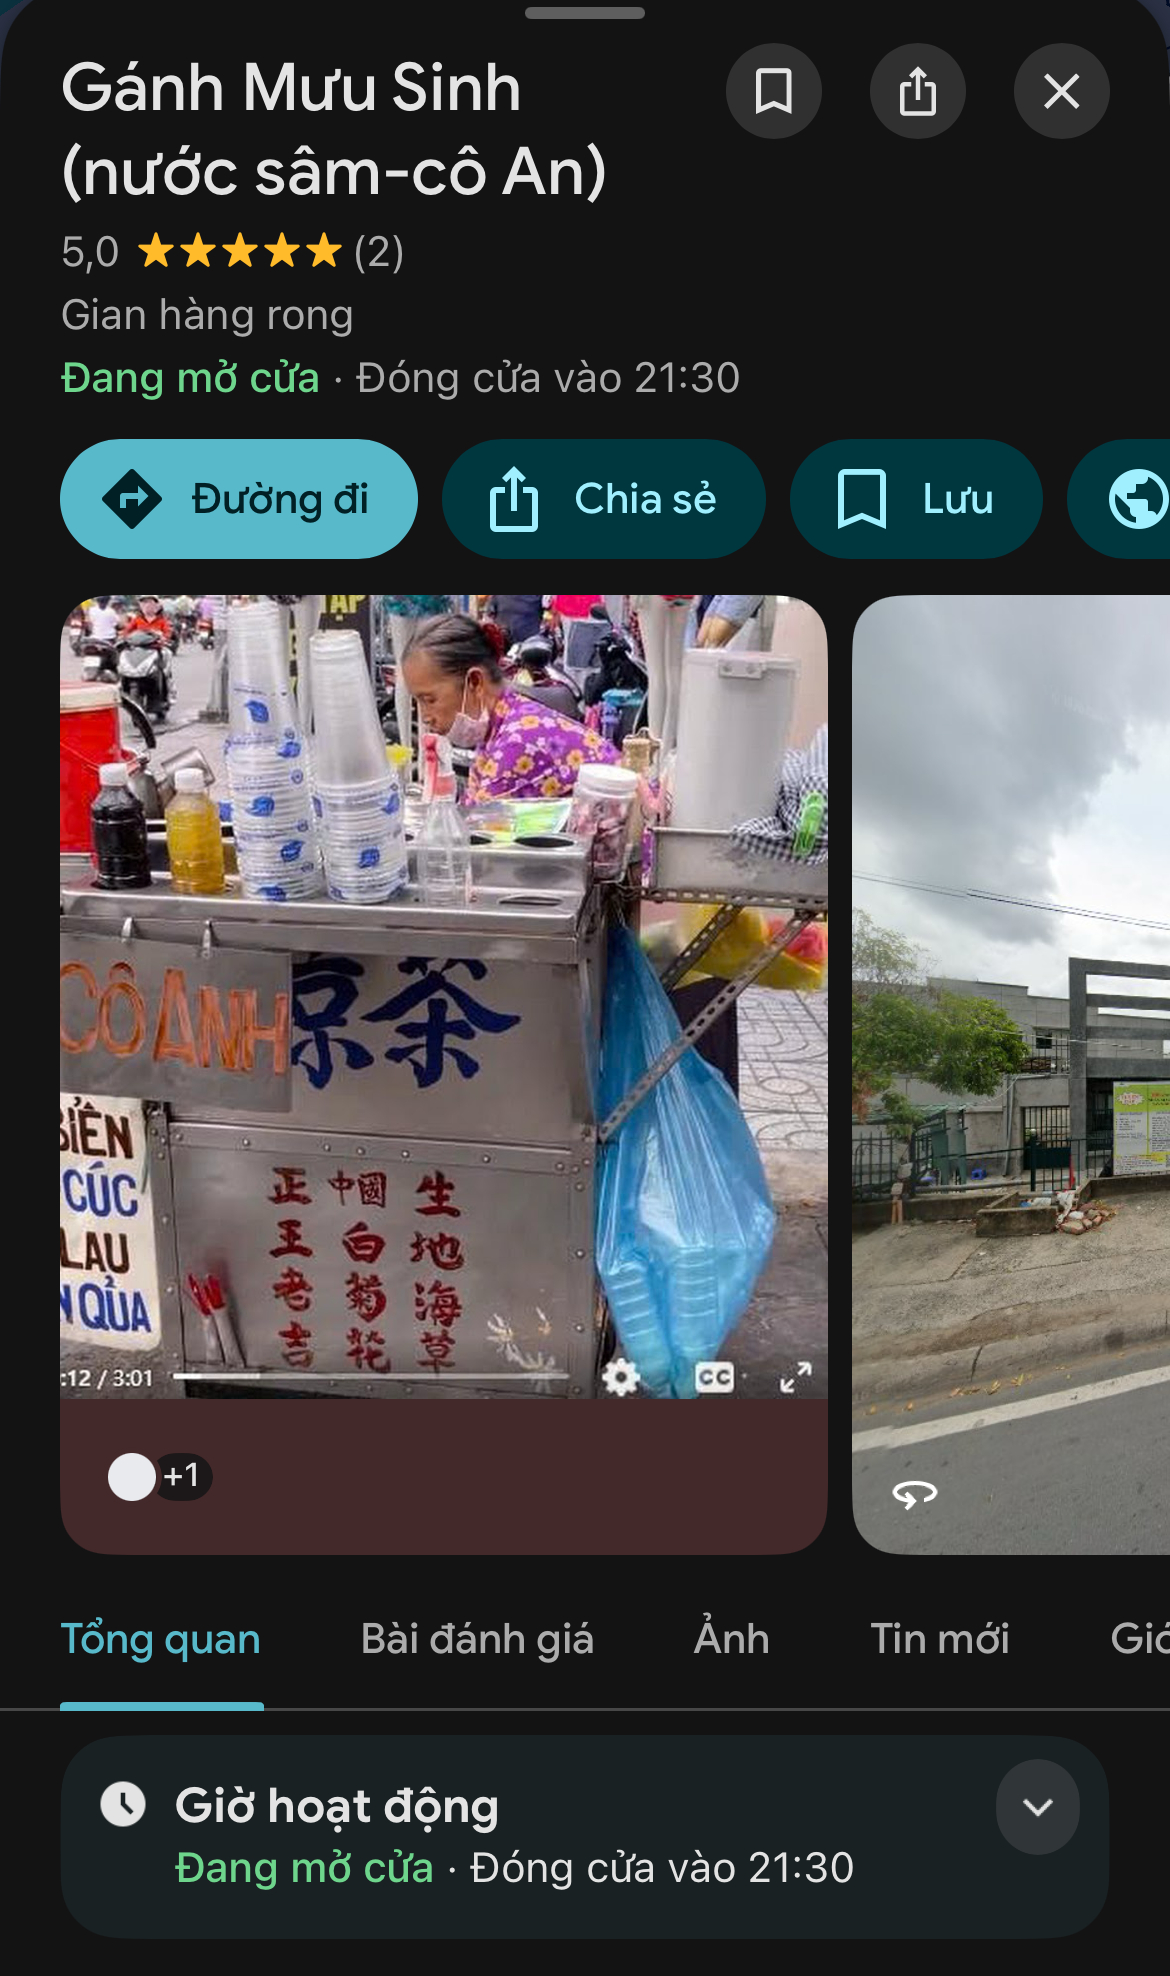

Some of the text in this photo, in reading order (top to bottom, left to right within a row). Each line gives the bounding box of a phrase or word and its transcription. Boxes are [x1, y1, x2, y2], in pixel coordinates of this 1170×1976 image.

[62, 60, 520, 112] Gánh Mưu Sinh
[63, 142, 605, 204] (nước sâm-cô An)
[62, 234, 403, 275] 5,0 (2)
[62, 296, 352, 338] Gian hàng rong
[60, 358, 740, 401] Đang mở cửa Đóng cửa vào 21:30
[191, 481, 368, 524] Đường đi
[575, 479, 717, 515] Chia sẻ
[924, 482, 993, 515] Lưu
[60, 961, 289, 1076] CÔ ANH
[62, 1161, 138, 1217] CÚC
[60, 1226, 130, 1274] LAU
[163, 1462, 198, 1488] +1
[60, 1616, 260, 1664] Tổng quan
[362, 1621, 594, 1664] Bài đánh giá
[693, 1611, 769, 1654] Ảnh
[870, 1621, 1009, 1655] Tin mới
[175, 1785, 498, 1834] Giờ hoạt động
[174, 1848, 854, 1891] Đang mở cửa Đóng cửa vào 21:30
